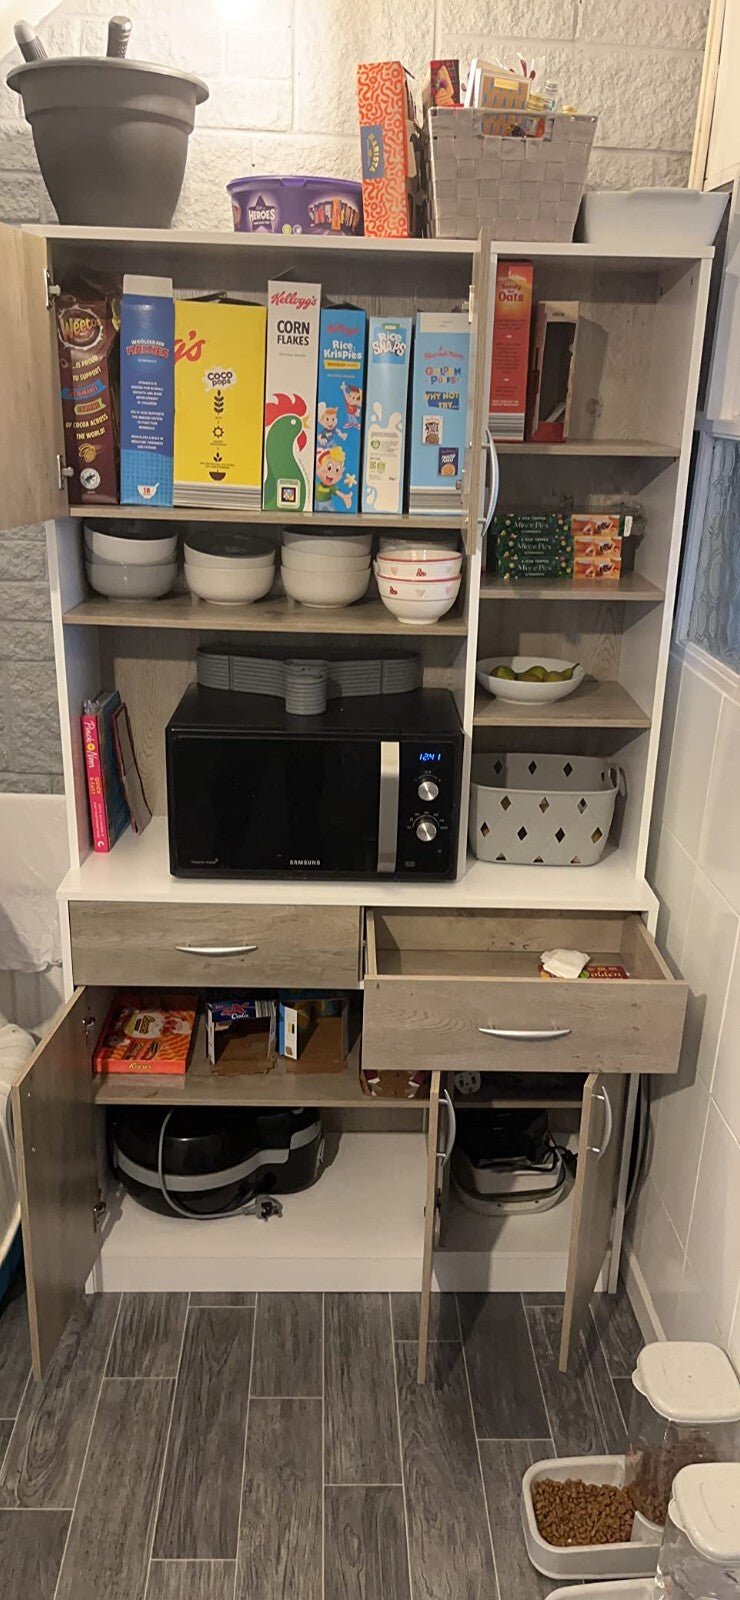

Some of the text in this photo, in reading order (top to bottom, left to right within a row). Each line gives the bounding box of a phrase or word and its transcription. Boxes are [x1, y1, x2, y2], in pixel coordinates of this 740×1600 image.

[367, 133, 380, 172] BARISTA
[248, 208, 276, 221] HEROES
[270, 290, 318, 310] Kellogg's
[498, 291, 524, 302] Oats
[277, 320, 310, 335] CORN
[277, 335, 310, 346] FLAKES
[378, 331, 402, 342] Rice
[332, 340, 354, 350] Rice
[372, 340, 407, 356] SNAPS
[323, 348, 362, 360] Krispies
[80, 366, 102, 381] SUPPORT
[212, 379, 231, 388] pops
[424, 391, 459, 400] WHY NOT
[73, 420, 90, 429] COCOA
[90, 414, 109, 427] ACROSS
[76, 432, 86, 440] THE
[514, 521, 535, 529] Mince
[517, 542, 538, 550] Mince
[518, 563, 538, 571] Mince
[84, 720, 95, 743] Pinch
[87, 750, 98, 768] Nom
[231, 1011, 249, 1020] Cola
